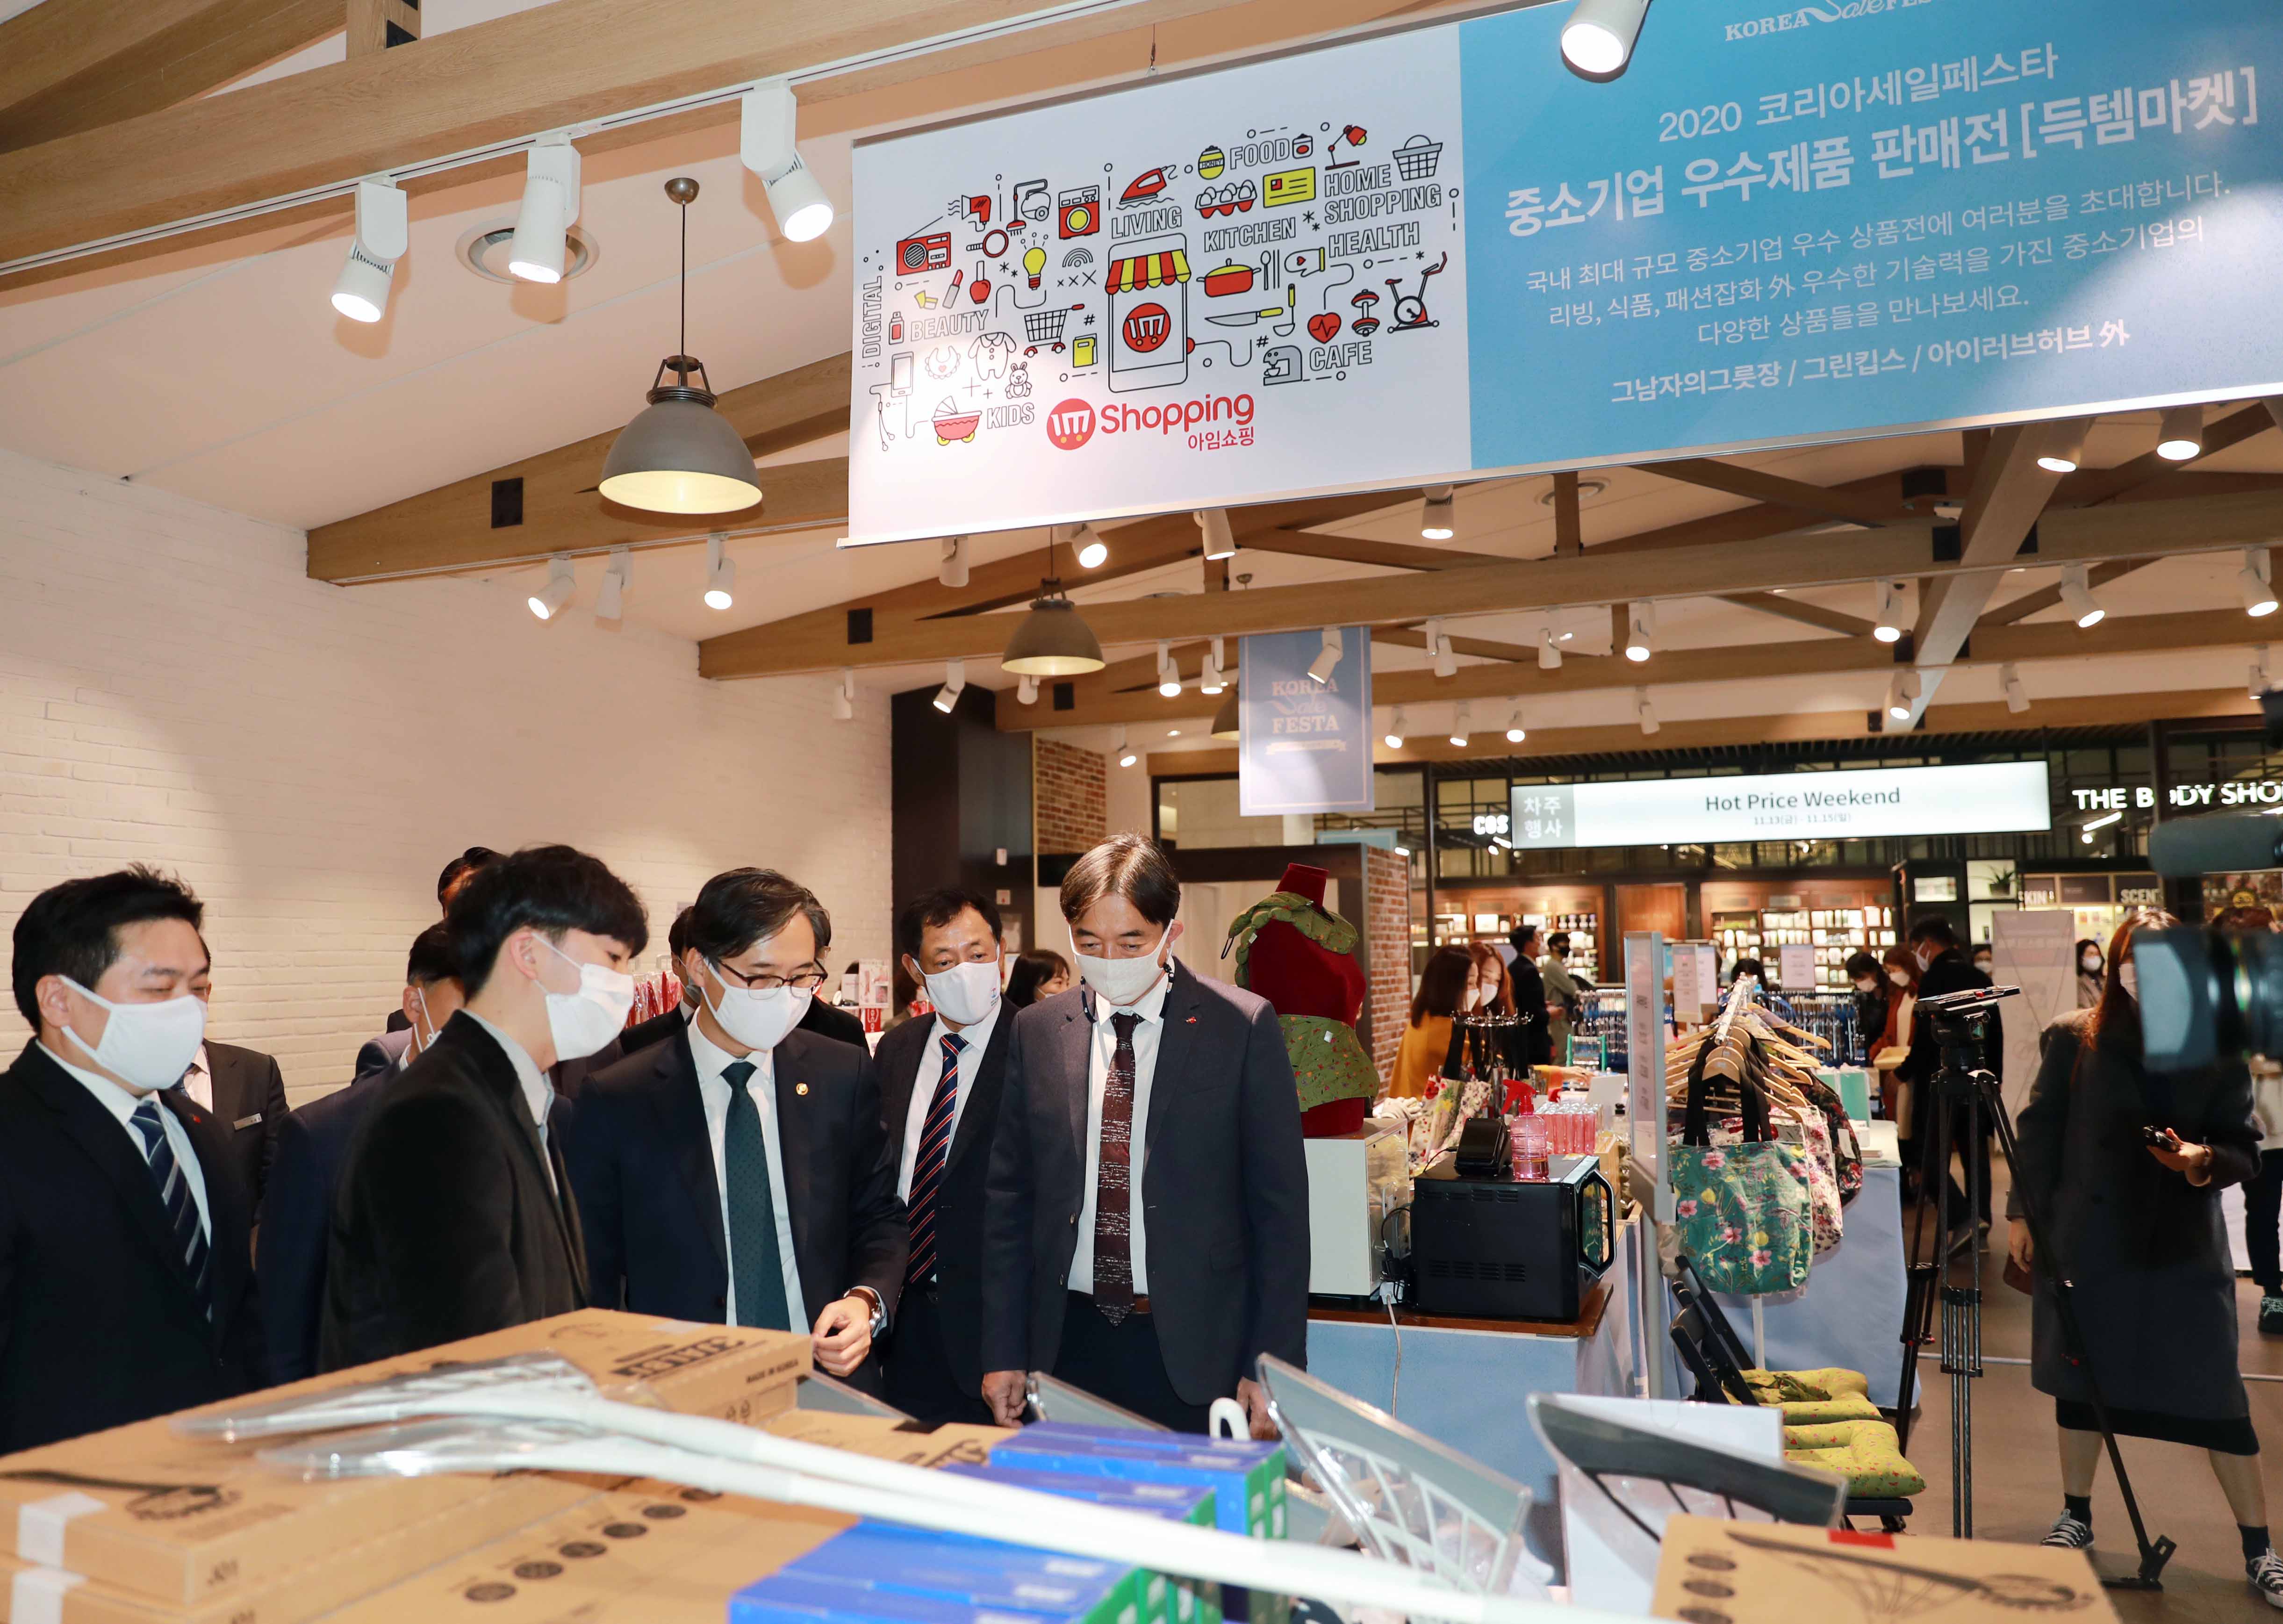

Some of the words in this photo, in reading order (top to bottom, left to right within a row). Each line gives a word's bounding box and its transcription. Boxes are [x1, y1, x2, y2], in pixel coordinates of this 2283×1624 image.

[1725, 10, 1810, 41] KOREA
[1659, 101, 1742, 142] 2020
[1756, 43, 2059, 126] 코리아세일페스타
[1202, 159, 1222, 168] HONEY
[1230, 138, 1291, 170] FOOD
[1324, 165, 1391, 197] HOME
[1505, 165, 1664, 237] 중소기업
[1682, 136, 1854, 208] 우수제품
[1325, 184, 1442, 224] SHOPPING
[1112, 206, 1182, 239] LIVING
[1204, 217, 1296, 252] KITCHEN
[1526, 269, 1571, 294] 국내
[1579, 259, 1624, 286] 최대
[1632, 252, 1679, 280] 규모
[1686, 236, 1782, 273] 중소기업
[1792, 229, 1841, 257] 우수
[1850, 211, 1953, 249] 상품전에
[1962, 194, 2069, 232] 여러분을
[2079, 171, 2231, 216] 초대합니다.
[1328, 221, 1420, 258] HEALTH
[1549, 302, 1601, 327] 리빙,
[1607, 293, 1660, 319] 식품,
[1665, 277, 1763, 312] 패션잡화
[1769, 275, 1795, 300] 外
[1802, 262, 1877, 295] 우수한
[1886, 246, 1991, 282] 기술력을
[2000, 237, 2053, 266] 가진
[2061, 216, 2204, 259] 중소기업의
[862, 276, 882, 358] DIGITAL
[910, 309, 989, 342] BEAUTY
[1699, 319, 1771, 346] 다양한
[1779, 301, 1880, 335] 상품들을
[1888, 284, 2030, 323] 만나보세요.
[1309, 341, 1372, 372] CAFE
[1611, 361, 1782, 403] 그남자의그릇장
[1803, 349, 1907, 382] 그린킵스
[1928, 325, 2093, 366] 아이러브허브
[986, 402, 1035, 429] KIDS
[1100, 394, 1255, 435] Shopping
[1188, 426, 1255, 451] 아임쇼핑
[1271, 715, 1339, 733] FESTA
[1523, 796, 1562, 816] 차주
[1706, 795, 1742, 812] Hot
[1747, 792, 1798, 810] Price
[1804, 787, 1900, 807] Weekend
[2072, 788, 2127, 810] THE
[2220, 781, 2283, 805] SHO
[1523, 819, 1563, 839] 행사
